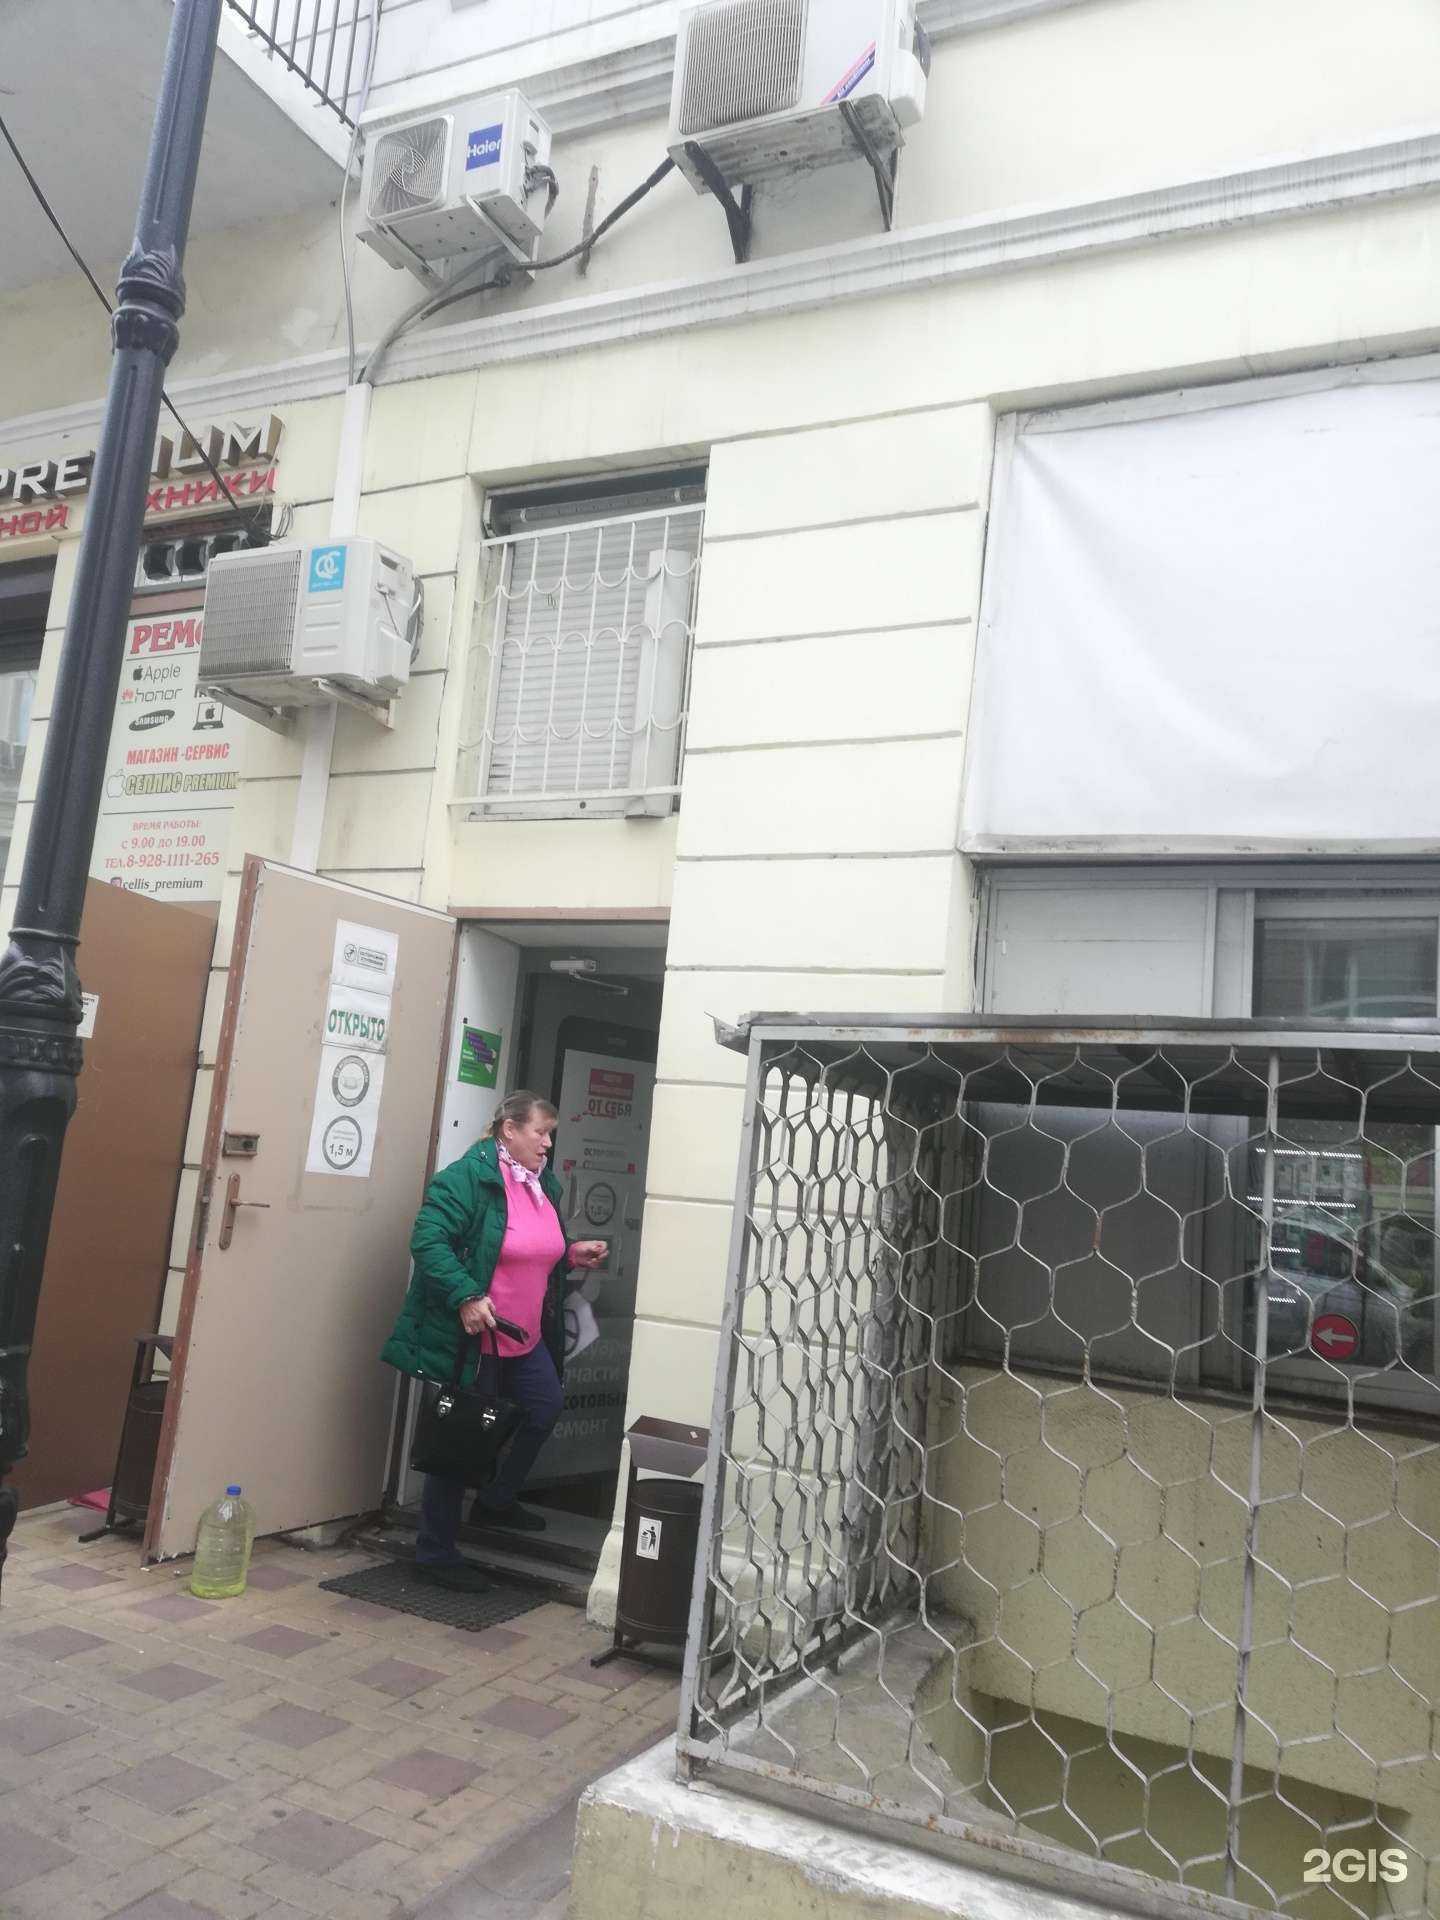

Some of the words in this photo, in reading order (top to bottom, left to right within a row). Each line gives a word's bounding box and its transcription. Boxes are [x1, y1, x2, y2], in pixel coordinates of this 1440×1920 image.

[467, 139, 501, 158] Haier
[0, 413, 281, 502] REIUM
[146, 466, 276, 512] ХНИКИ
[143, 664, 181, 684] Apple
[135, 688, 183, 703] honor
[127, 746, 179, 765] МАГАЗИН
[183, 772, 239, 792] PREMIUM
[132, 821, 161, 832] ВРЕМЯ
[131, 837, 155, 849] 9.00
[159, 838, 173, 848] до
[176, 835, 206, 848] 19.00
[327, 1008, 386, 1042] ОТКРЫТО
[588, 1098, 602, 1113] ОТ
[605, 1101, 632, 1117] СЕБЯ
[329, 1143, 345, 1159] 1,5
[552, 1417, 609, 1440] емонт
